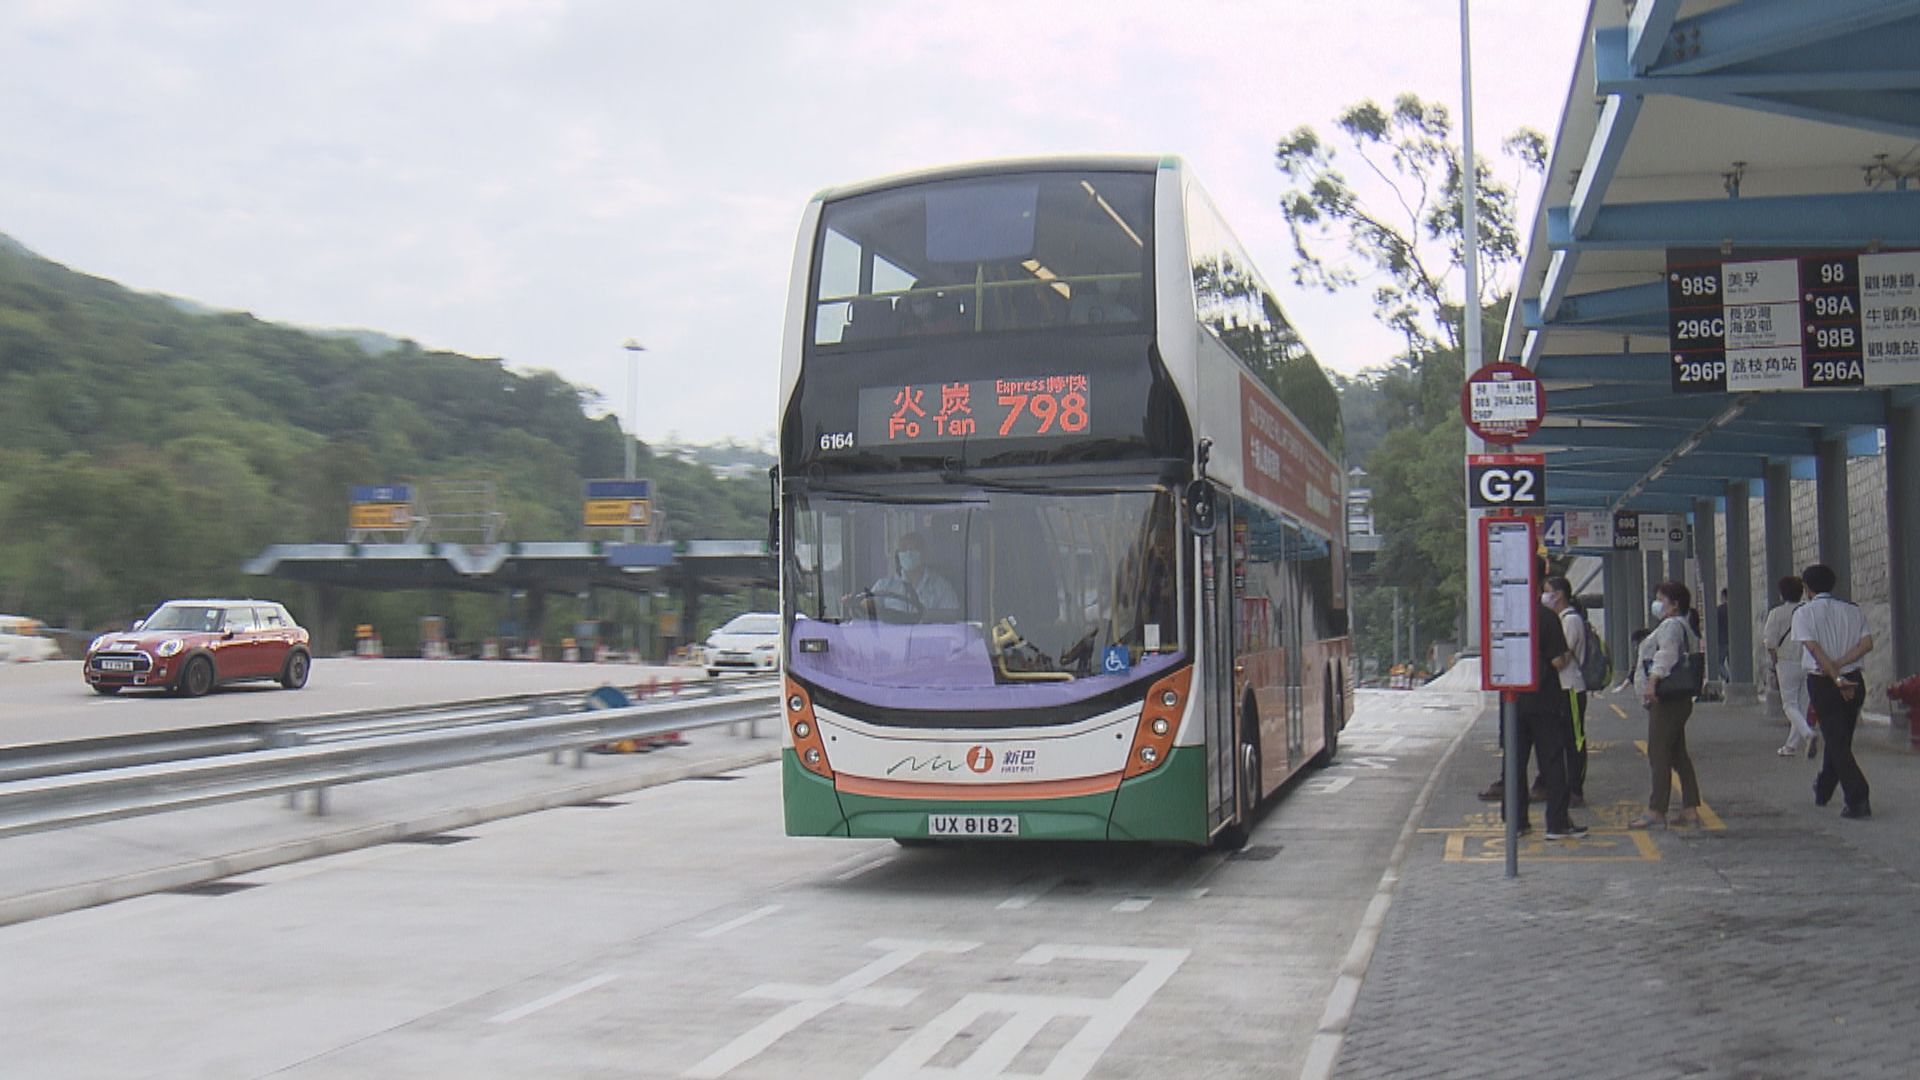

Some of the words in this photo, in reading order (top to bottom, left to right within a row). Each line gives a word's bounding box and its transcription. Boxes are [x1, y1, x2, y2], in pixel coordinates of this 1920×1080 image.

[1820, 263, 1845, 283] 98
[1864, 273, 1920, 290] 觀塘道
[1681, 276, 1717, 296] 98S
[1815, 295, 1854, 316] 98A
[1866, 307, 1920, 322] 牛頭角
[1678, 319, 1724, 340] 296C
[1817, 327, 1855, 348] 98B
[1680, 361, 1725, 382] 296P
[1813, 360, 1863, 382] 296A
[995, 379, 1045, 394] Express
[892, 382, 973, 418] 火炭
[997, 392, 1089, 436] 798
[888, 415, 921, 440] Fo
[933, 414, 976, 436] Tan
[820, 432, 854, 452] 6164
[1479, 469, 1535, 503] G2
[1002, 749, 1036, 766] 新巴
[934, 817, 958, 833] UX
[965, 817, 1014, 834] 8182
